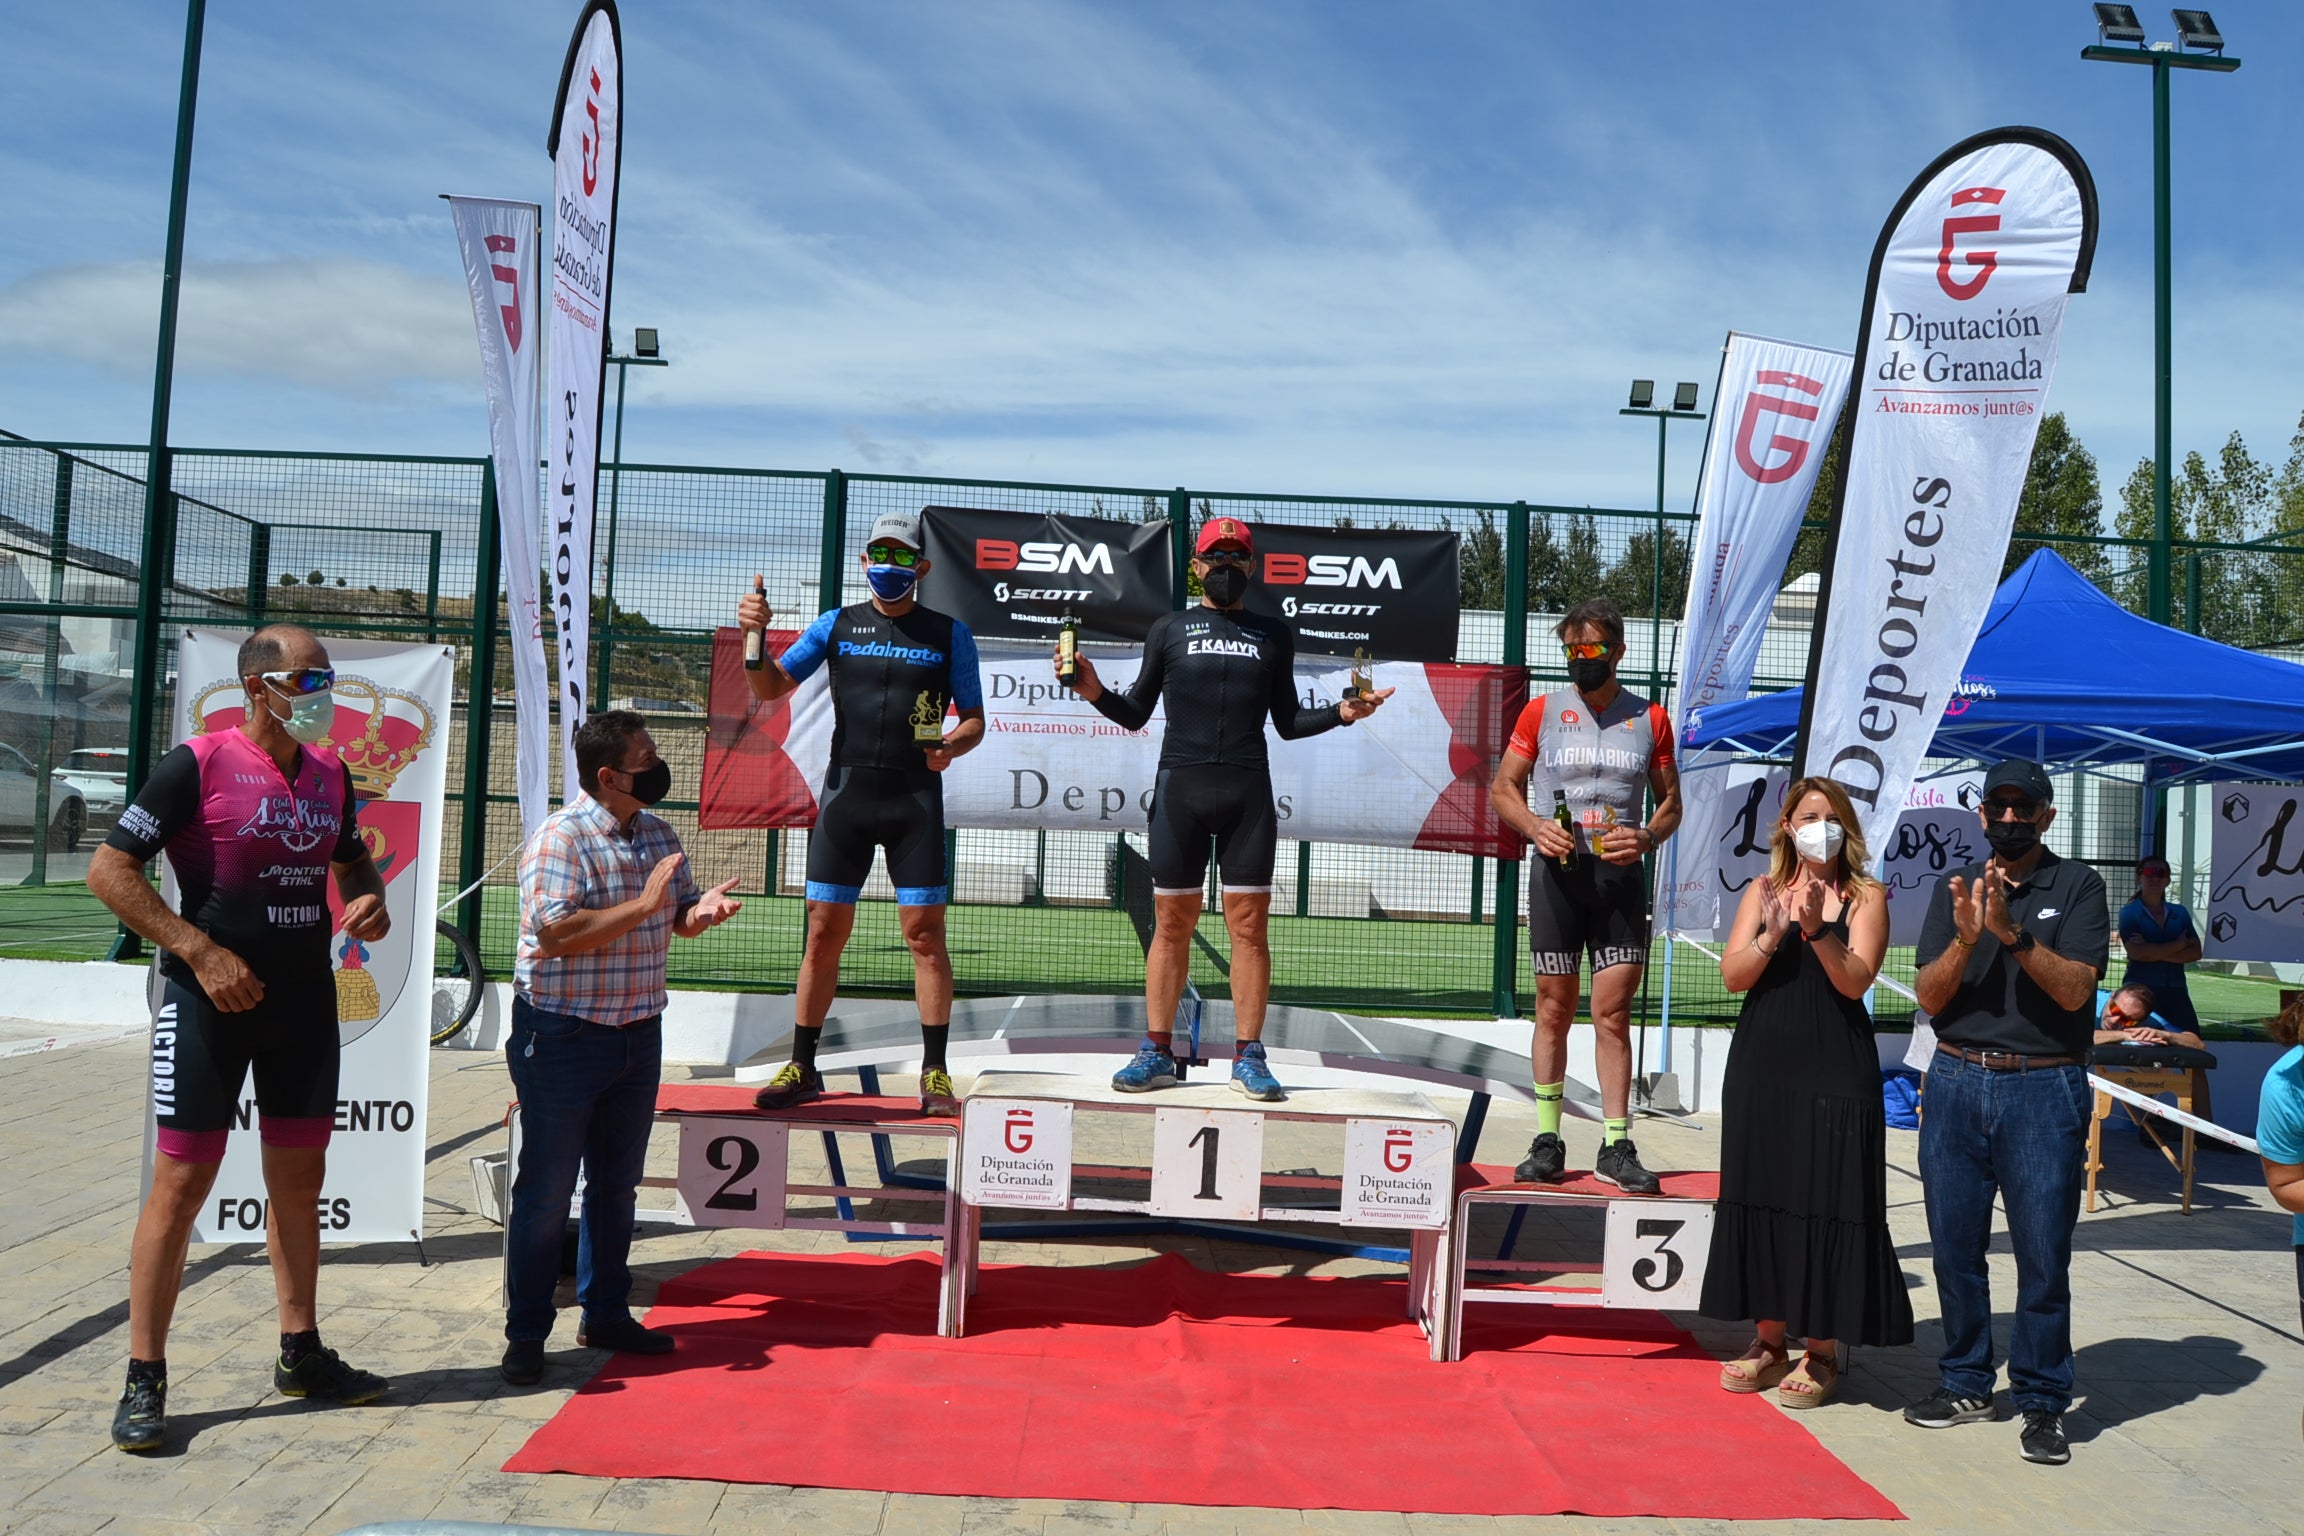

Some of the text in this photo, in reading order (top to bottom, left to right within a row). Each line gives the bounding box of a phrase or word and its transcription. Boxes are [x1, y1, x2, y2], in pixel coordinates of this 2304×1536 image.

[1884, 308, 2042, 350] Diputación
[1878, 347, 2043, 384] de Granada
[1875, 395, 2035, 420] Avanzamos junt@s
[976, 538, 1115, 575] BSM
[1263, 553, 1403, 590] BSM
[1011, 588, 1093, 601] SCOTT
[1299, 602, 1382, 616] SCOTT
[1300, 627, 1370, 641] BSMBIKES.COM
[1828, 475, 1953, 813] Deportes
[837, 640, 946, 665] Pedalmoto
[1187, 638, 1261, 660] E.KAMYR
[988, 716, 1150, 738] Avanzamos junt@s
[1545, 746, 1646, 773] LAGUNABIKES
[259, 864, 326, 878] MONTIEL
[279, 876, 314, 886] STIHL
[267, 904, 320, 924] VICTORIA
[152, 1002, 177, 1117] VICTORIA
[705, 1135, 760, 1211] 2
[980, 1155, 1054, 1172] Diputación
[1188, 1126, 1223, 1200] 1
[980, 1171, 1053, 1187] de Granada
[1359, 1174, 1433, 1191] Diputación
[981, 1190, 1024, 1200] Avanzamos
[1358, 1190, 1432, 1206] de Granada
[1360, 1209, 1402, 1219] Avanzamos
[1632, 1218, 1687, 1292] 3
